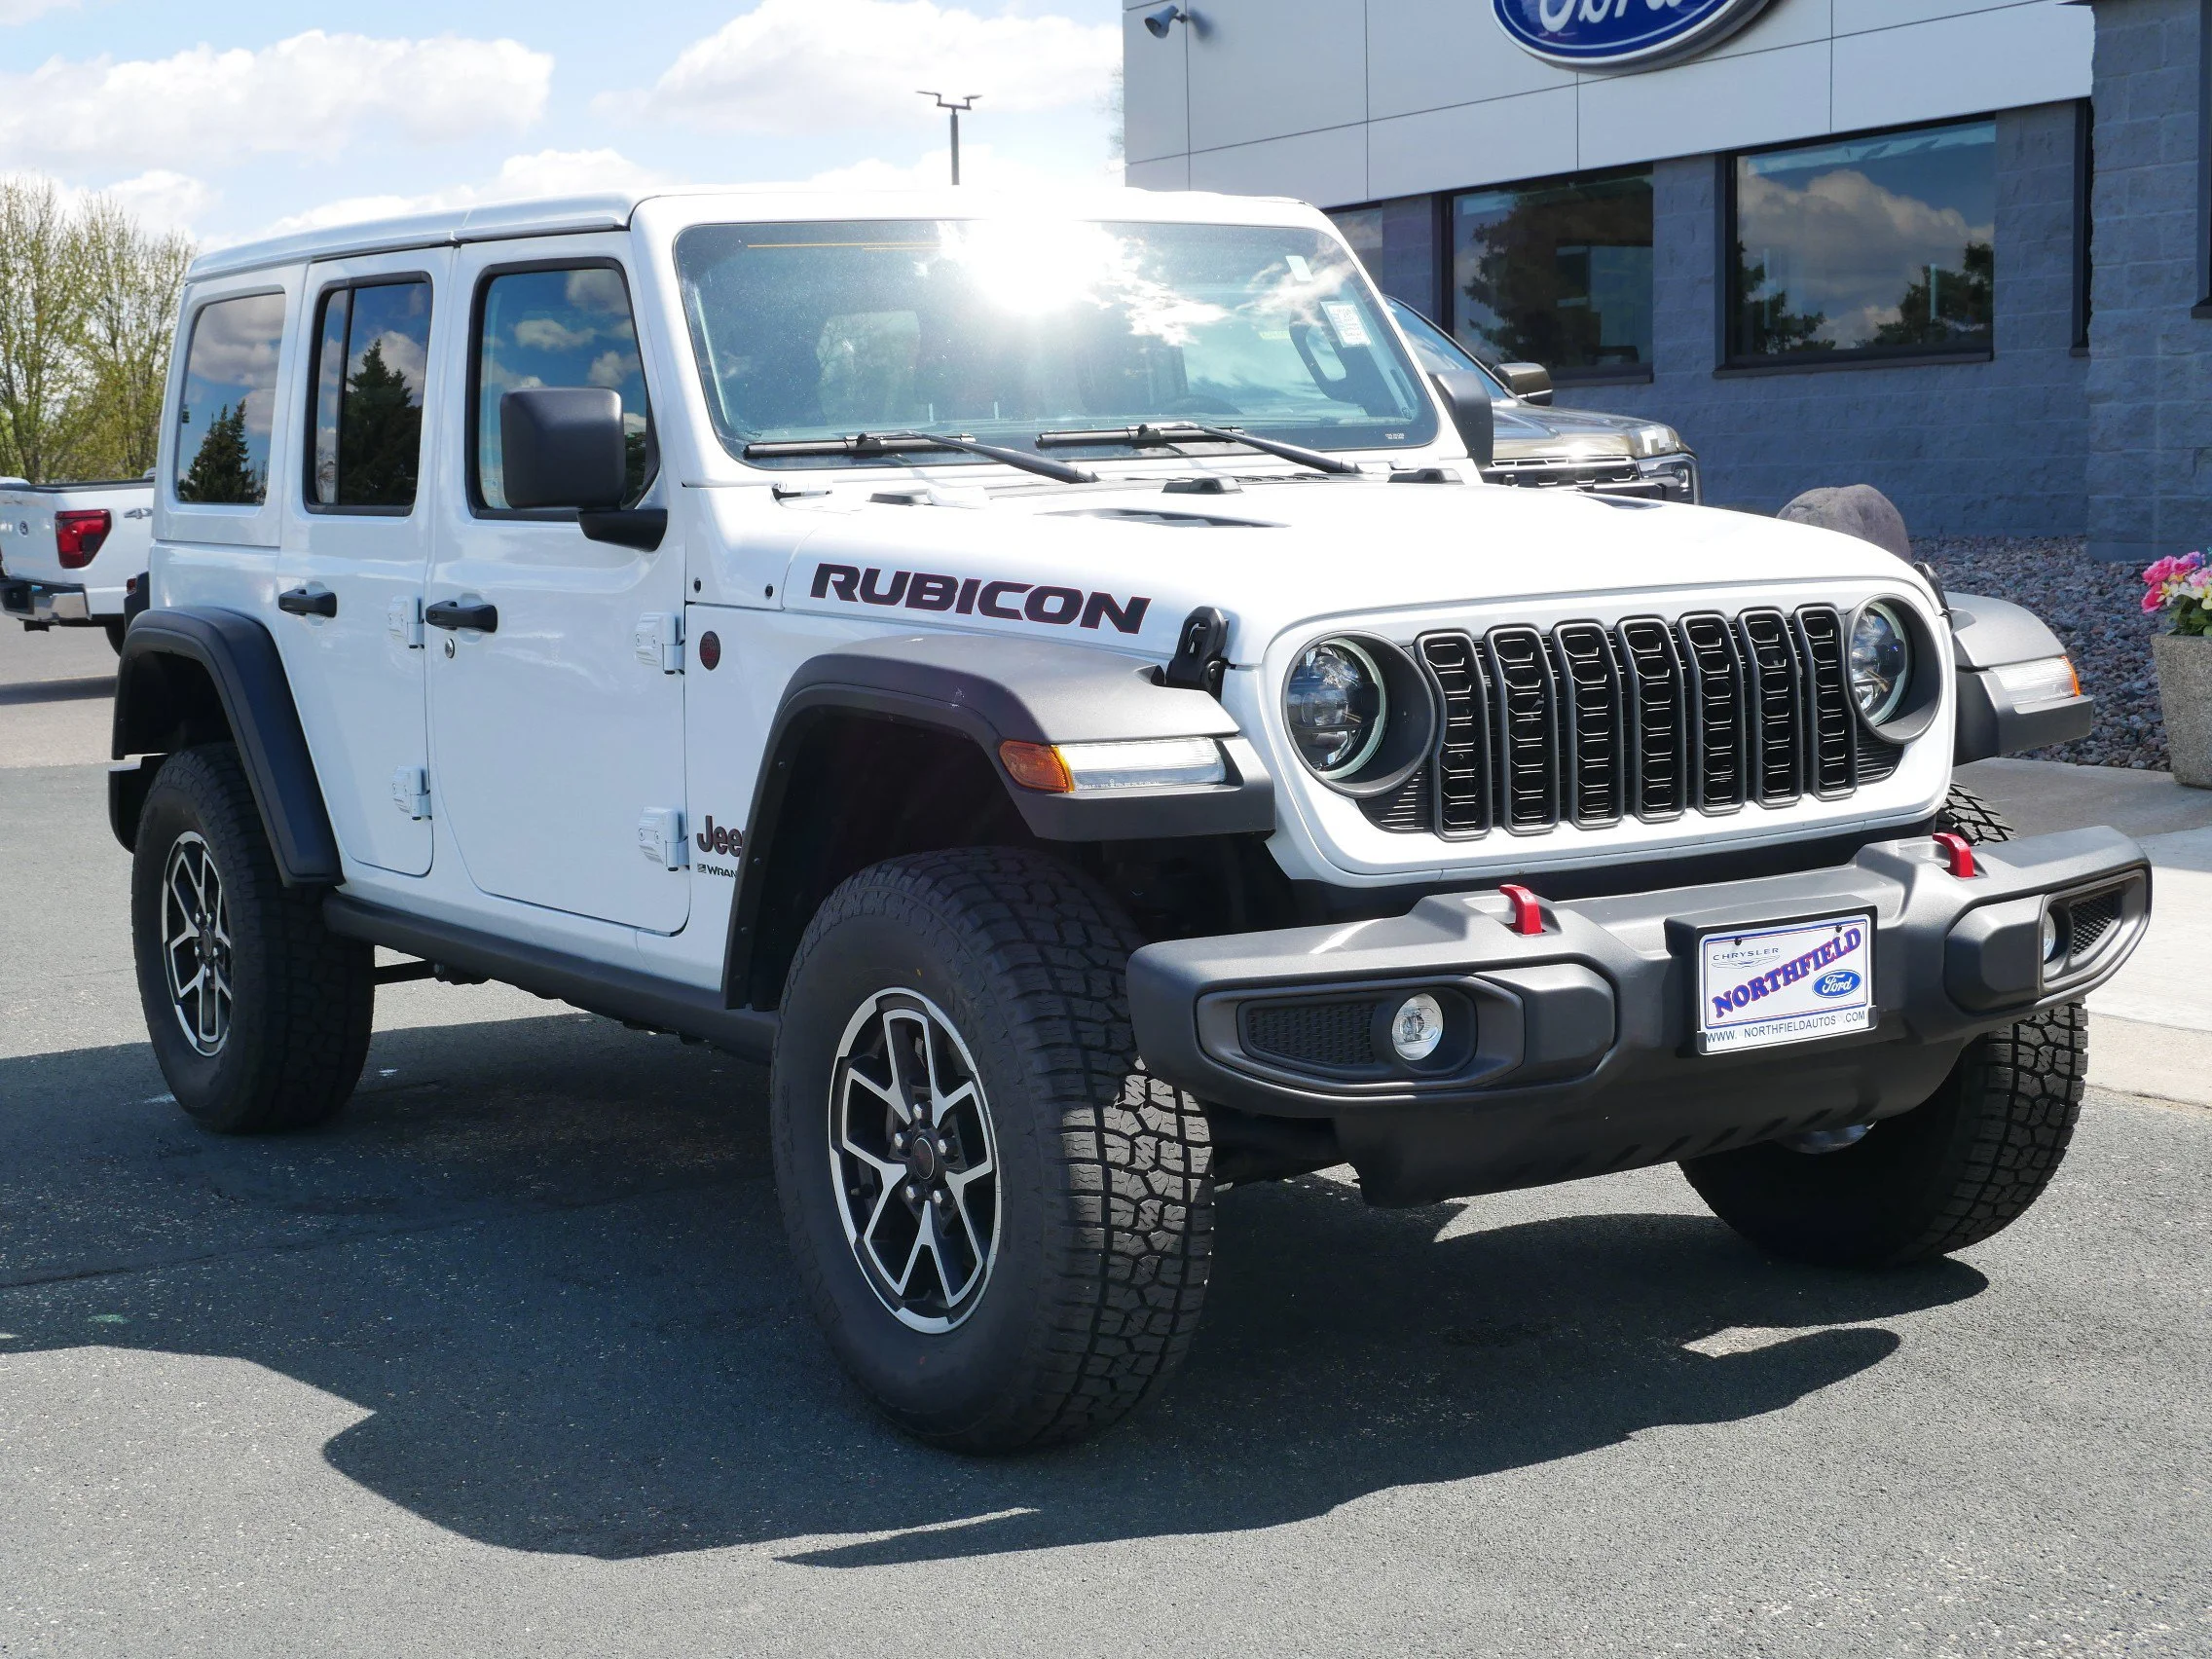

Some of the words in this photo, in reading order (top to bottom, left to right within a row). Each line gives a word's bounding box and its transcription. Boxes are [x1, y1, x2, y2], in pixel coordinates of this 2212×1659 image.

[809, 562, 1153, 635] RUBICON
[696, 814, 745, 858] Jee
[707, 864, 737, 878] WRAN
[1713, 947, 1779, 961] CHRYSLER
[1712, 927, 1862, 1018] NORTHFIELD
[1822, 974, 1853, 994] Ford
[1744, 1014, 1836, 1039] NORTHFIELDAUTOS
